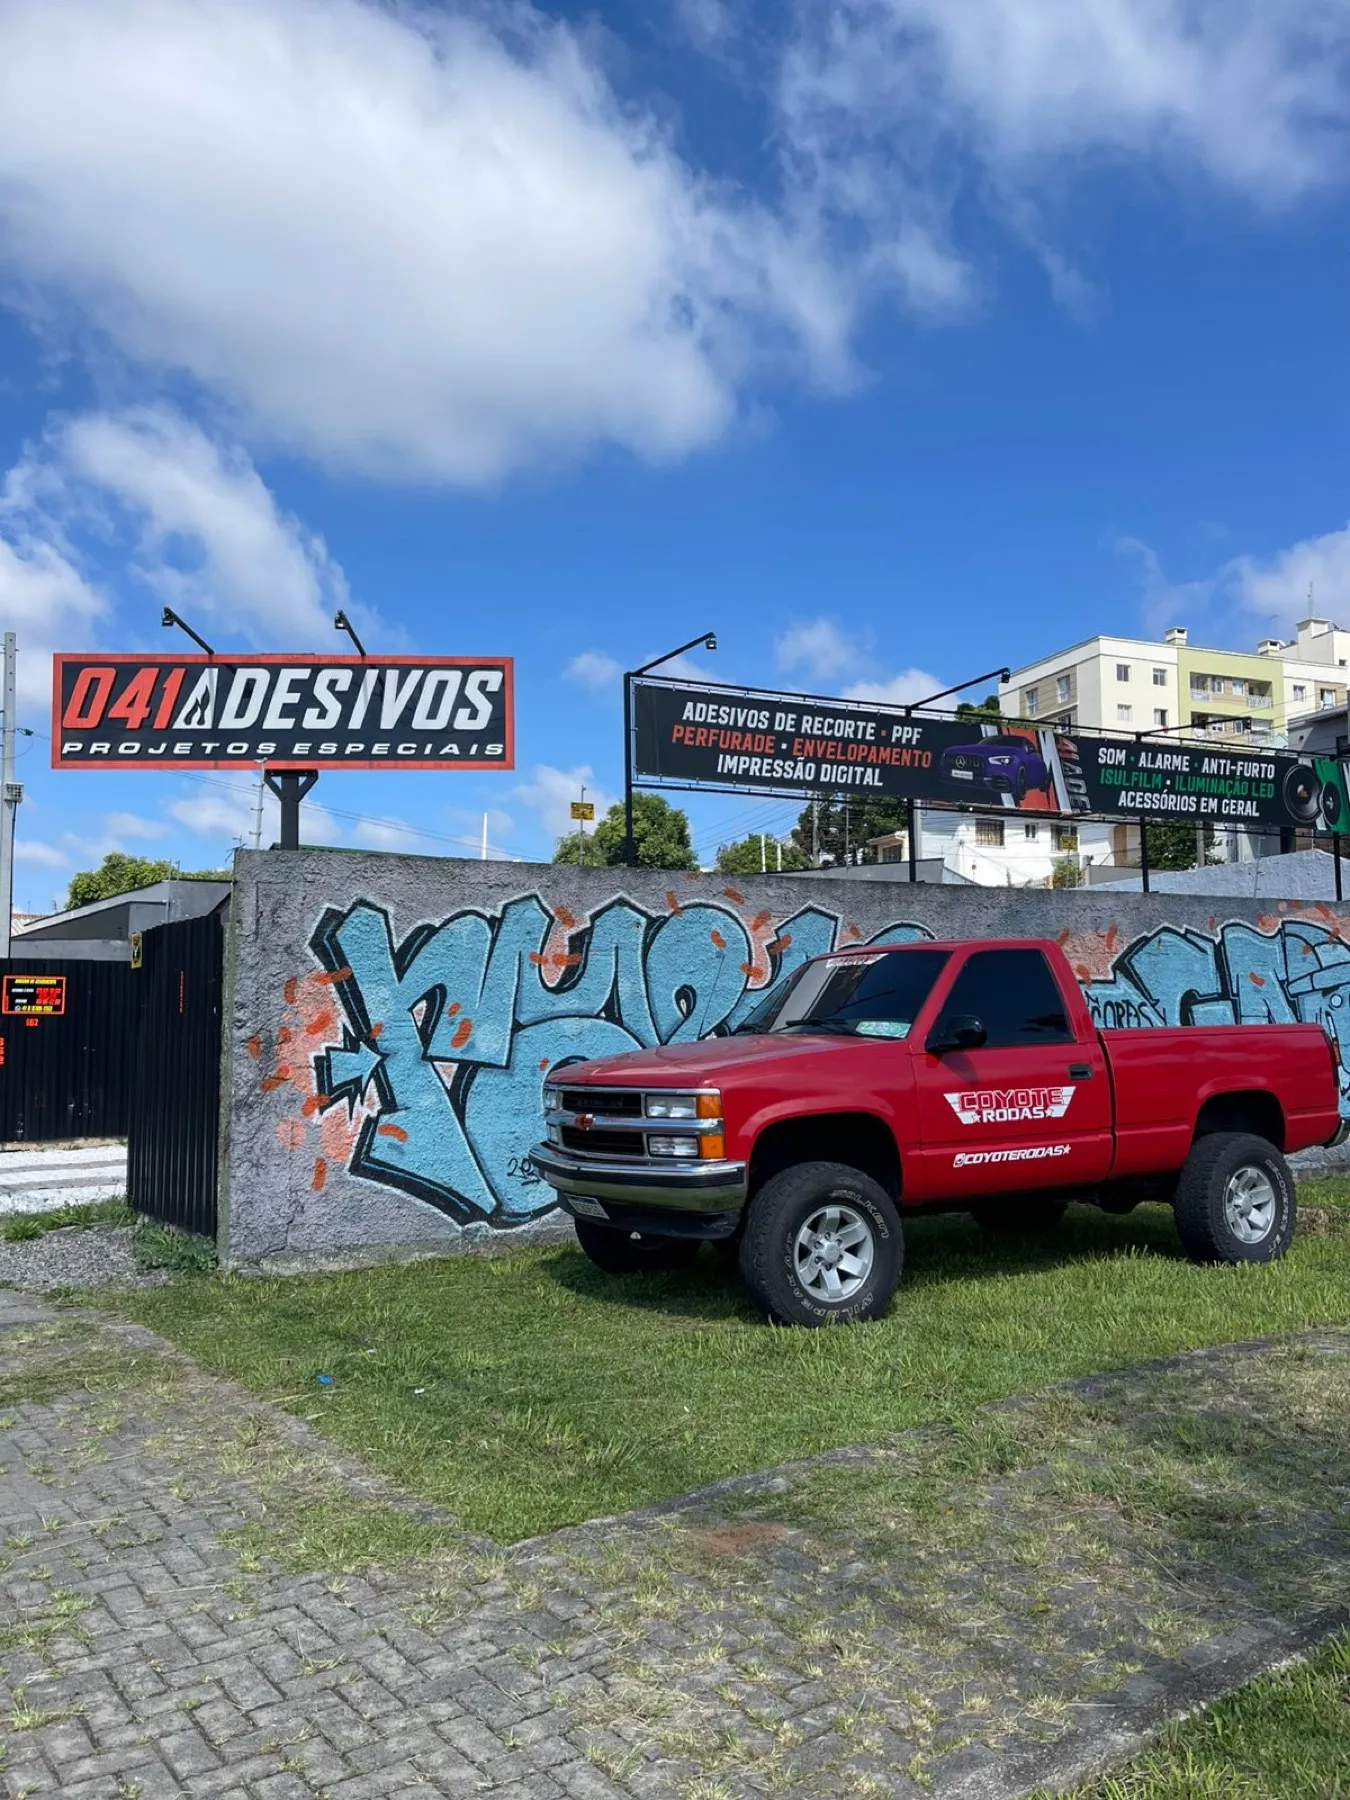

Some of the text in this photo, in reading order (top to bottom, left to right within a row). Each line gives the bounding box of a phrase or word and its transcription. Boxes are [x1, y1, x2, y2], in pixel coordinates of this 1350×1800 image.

[682, 701, 923, 746] ADESIVOS DE RECORTE PPF
[61, 741, 505, 757] PROJETOS ESPECIAIS
[671, 724, 933, 769] PERFURADE ENVELOPAMENTO
[716, 754, 883, 787] IMPRESSÃO DIGITAL
[1097, 747, 1276, 781] SOM ALARME ANTI-FURTO
[1098, 767, 1275, 799] ISULFILM ILUMINAÇÃO LED
[1117, 788, 1260, 818] ACESSÓRIOS EM GERAL
[958, 1087, 1064, 1112] COYOTE
[982, 1107, 1045, 1124] RODAS
